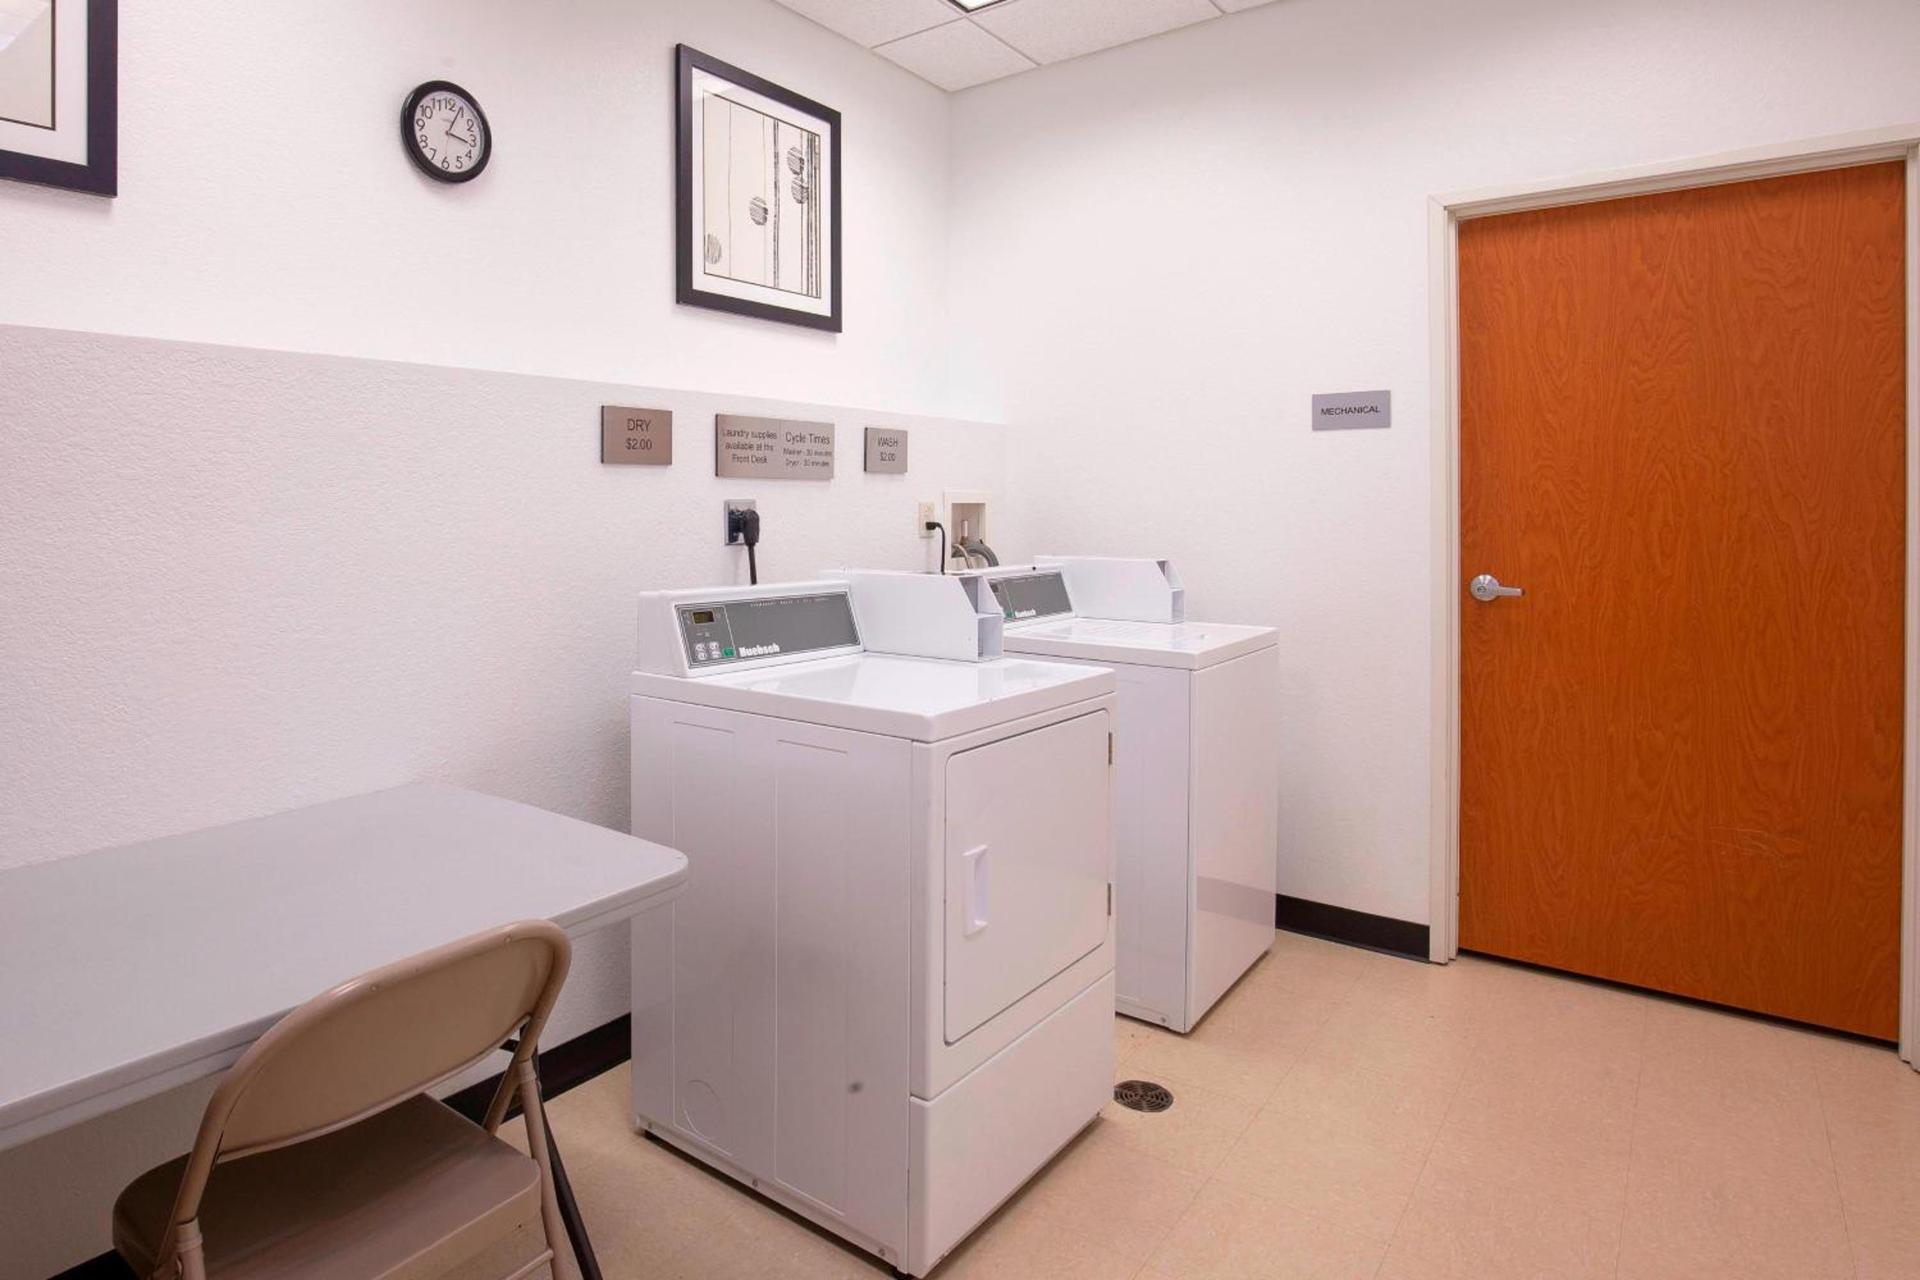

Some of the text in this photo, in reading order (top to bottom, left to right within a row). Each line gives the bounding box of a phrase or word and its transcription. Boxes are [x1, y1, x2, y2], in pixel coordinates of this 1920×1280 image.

[431, 97, 442, 111] 11
[443, 96, 456, 112] 12
[420, 104, 433, 120] 10
[416, 118, 425, 131] 9
[467, 119, 474, 132] 2
[420, 134, 428, 149] 8
[469, 134, 477, 148] 3
[429, 147, 437, 160] 7
[465, 149, 472, 159] 4
[441, 156, 450, 170] 6
[456, 156, 463, 169] 5
[1321, 405, 1381, 416] MECHANICAL
[627, 418, 652, 432] DRY
[722, 428, 777, 440] Laundry supplies
[785, 431, 831, 445] Cycle Times
[625, 437, 653, 450] $2.00
[877, 436, 899, 448] WASH
